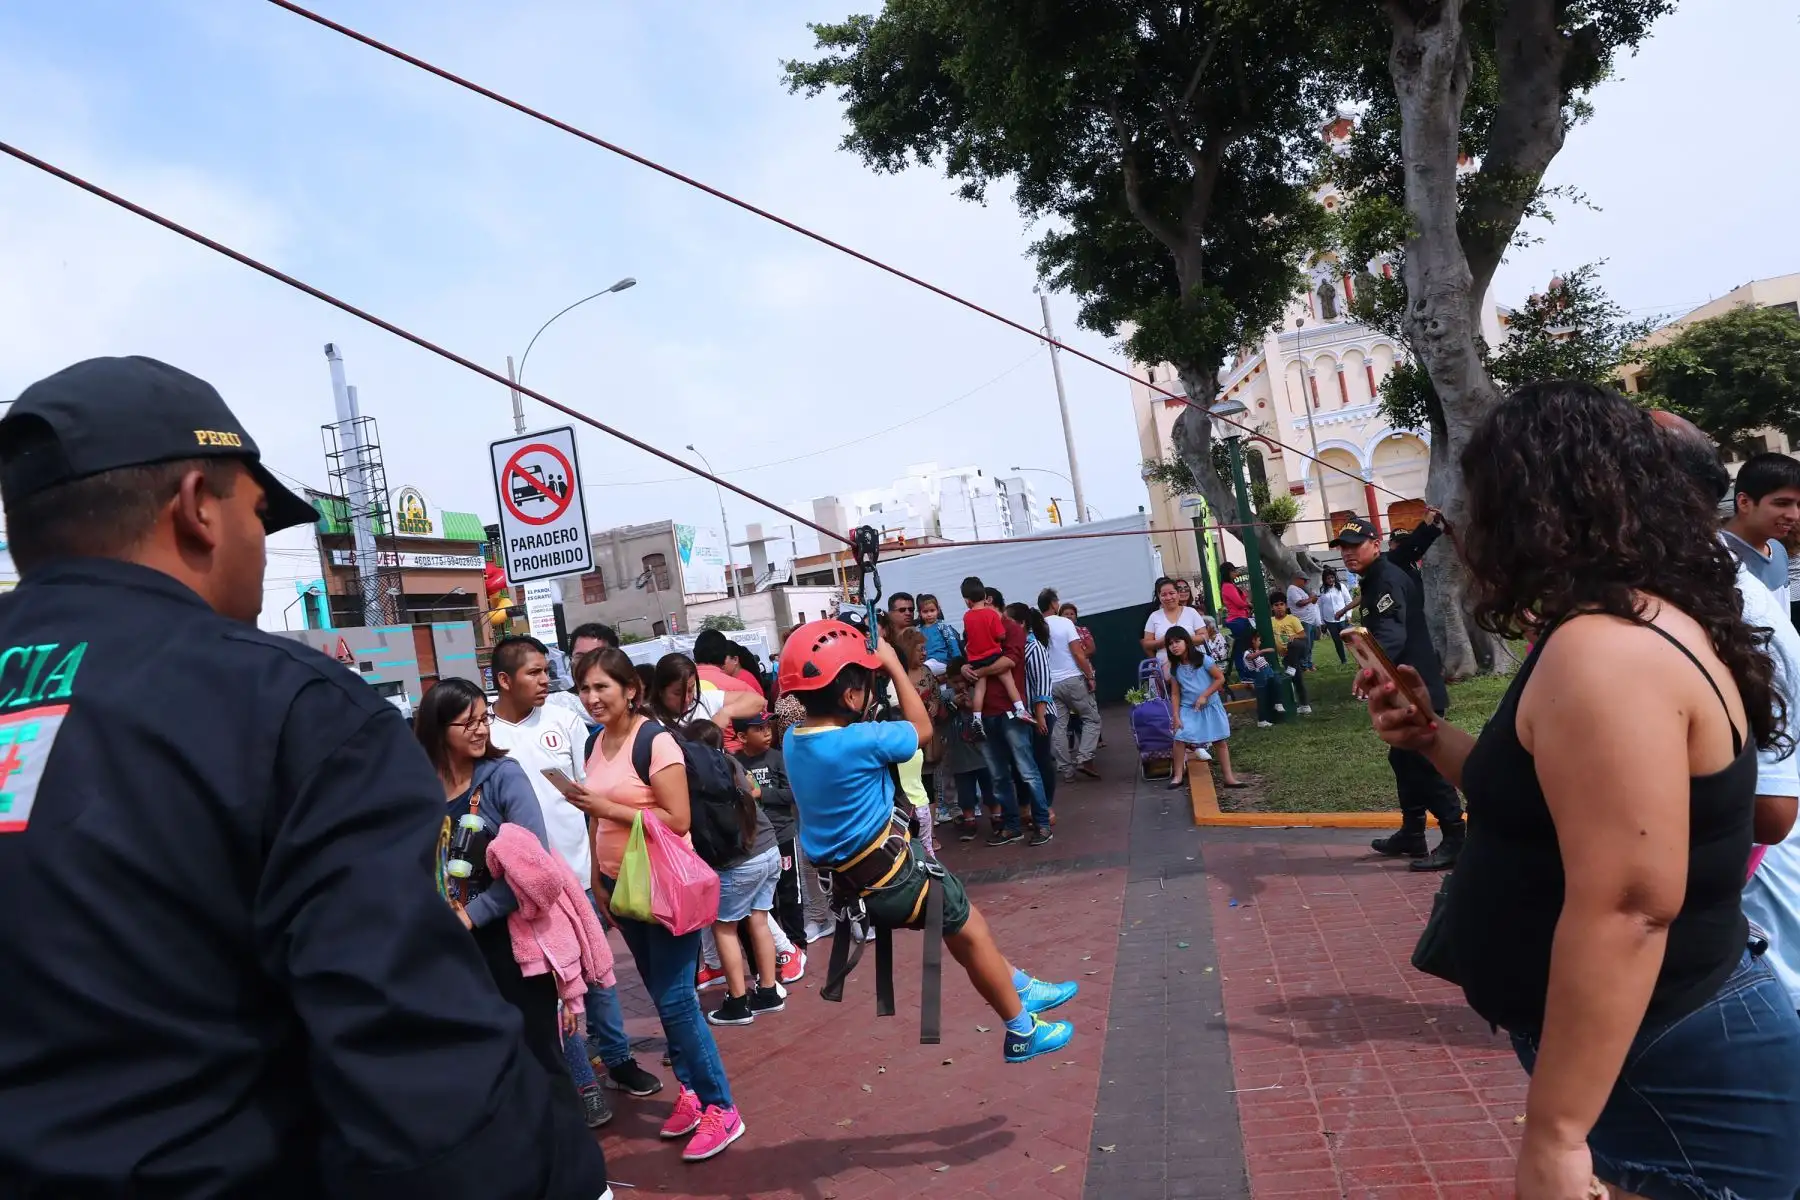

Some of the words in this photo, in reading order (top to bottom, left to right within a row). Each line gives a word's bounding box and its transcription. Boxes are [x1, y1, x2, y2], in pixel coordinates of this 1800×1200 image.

[510, 527, 578, 553] PARADERO
[514, 547, 583, 573] PROHIBIDO
[545, 735, 557, 748] U
[756, 772, 766, 780] DJ
